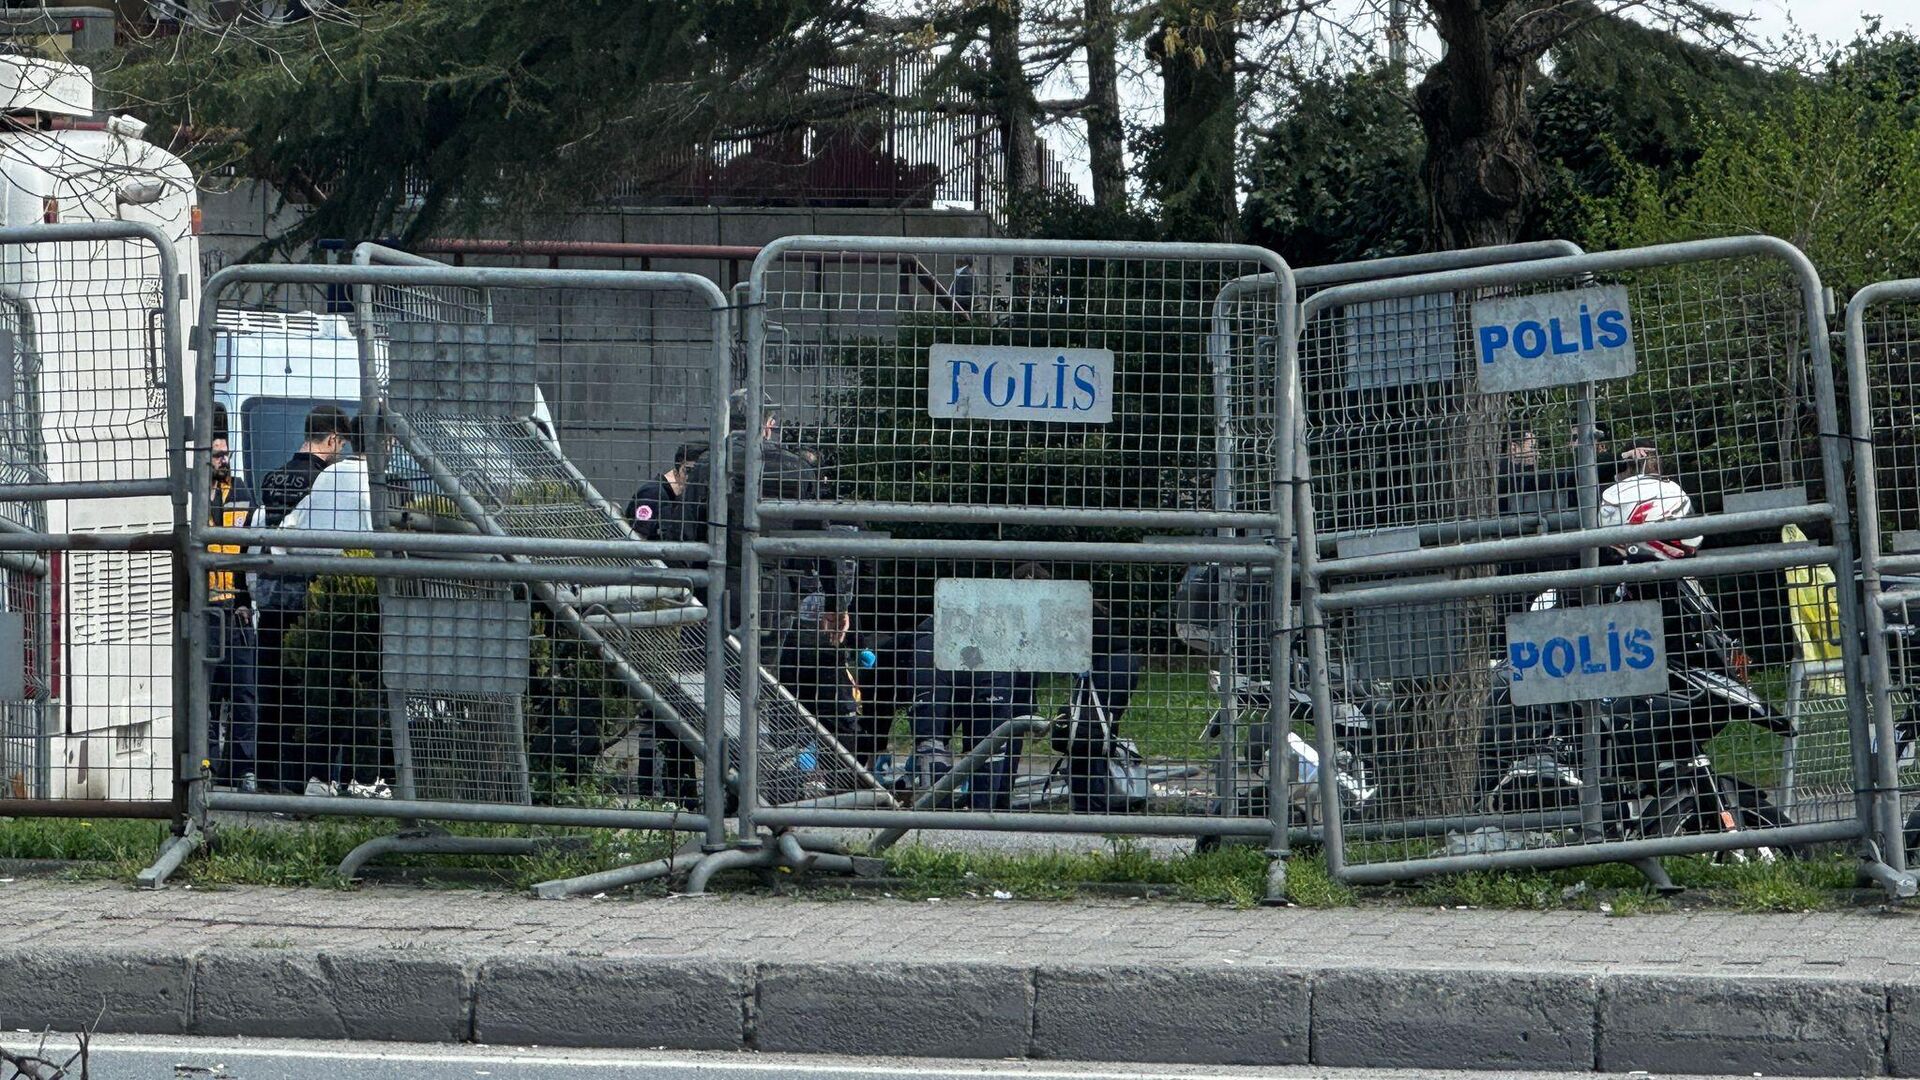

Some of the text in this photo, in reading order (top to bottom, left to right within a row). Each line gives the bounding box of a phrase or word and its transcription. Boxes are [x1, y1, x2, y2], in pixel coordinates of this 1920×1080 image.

[1480, 304, 1628, 363] POLİS
[946, 355, 1095, 411] POLİS
[1510, 621, 1655, 681] POLİS
